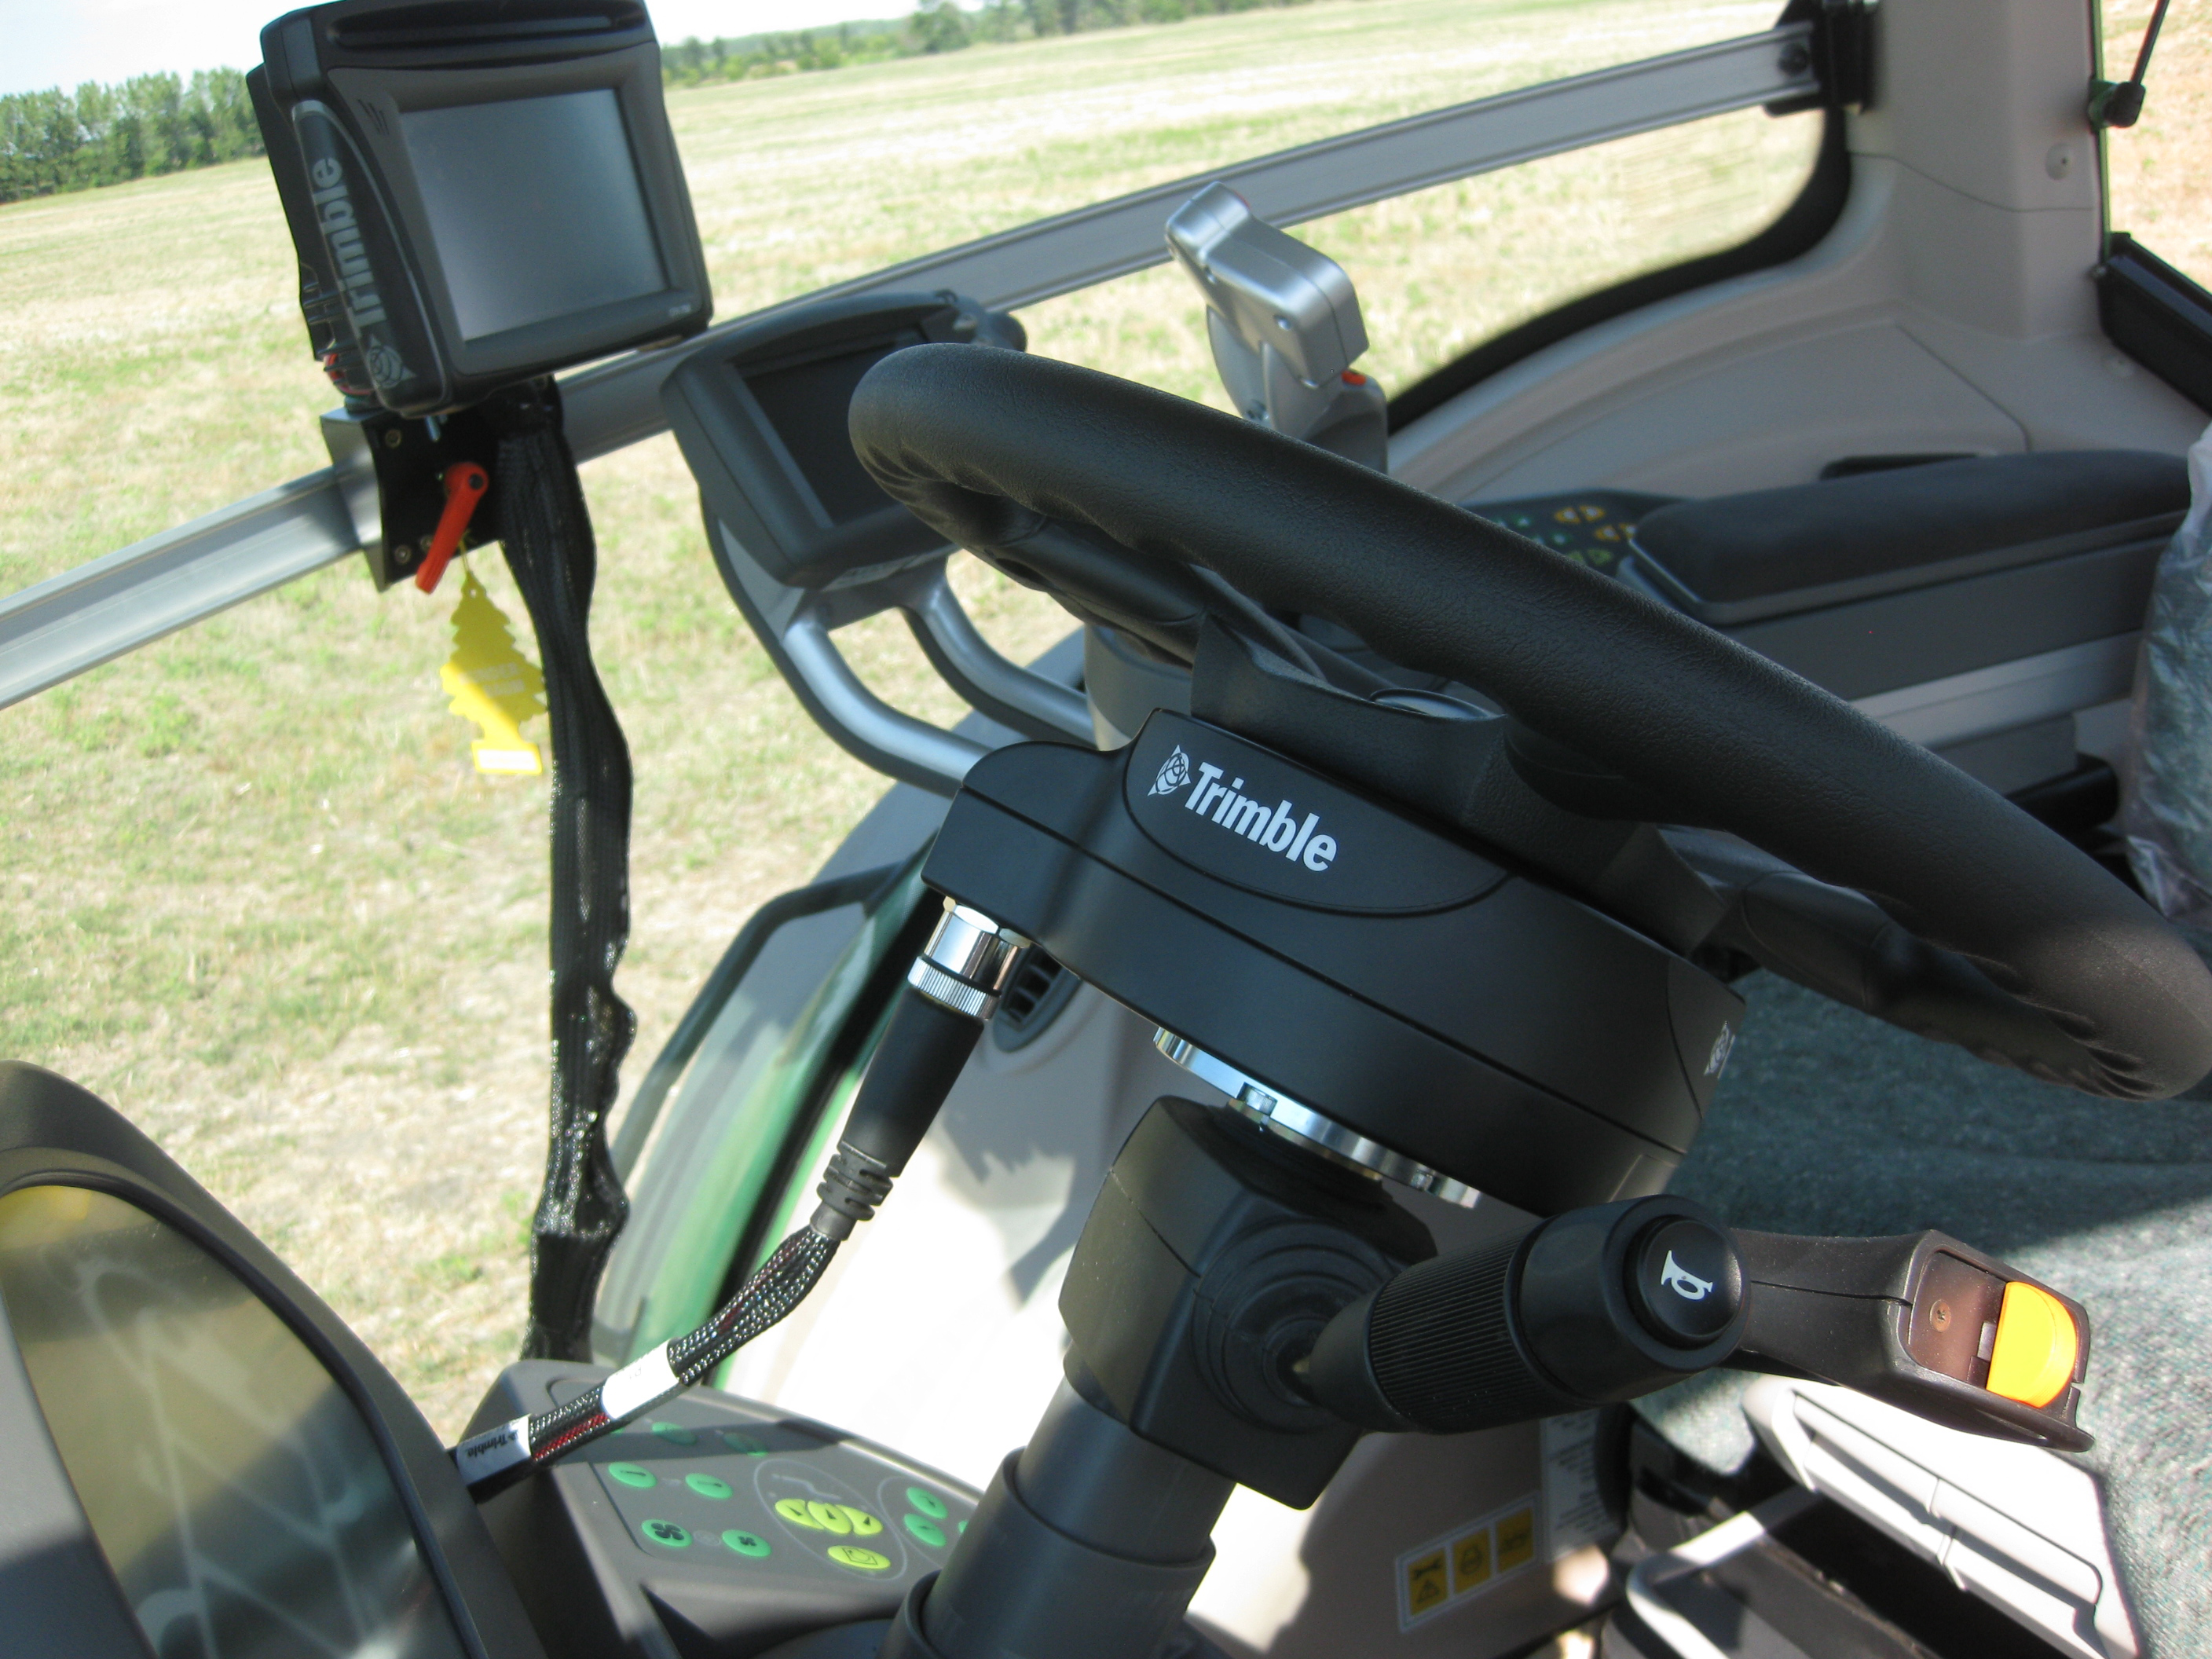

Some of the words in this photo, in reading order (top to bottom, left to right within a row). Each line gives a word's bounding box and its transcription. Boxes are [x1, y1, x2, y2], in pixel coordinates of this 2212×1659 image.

[311, 157, 387, 339] Trimble
[1185, 761, 1337, 872] Trimble
[467, 1434, 508, 1457] Trimble
